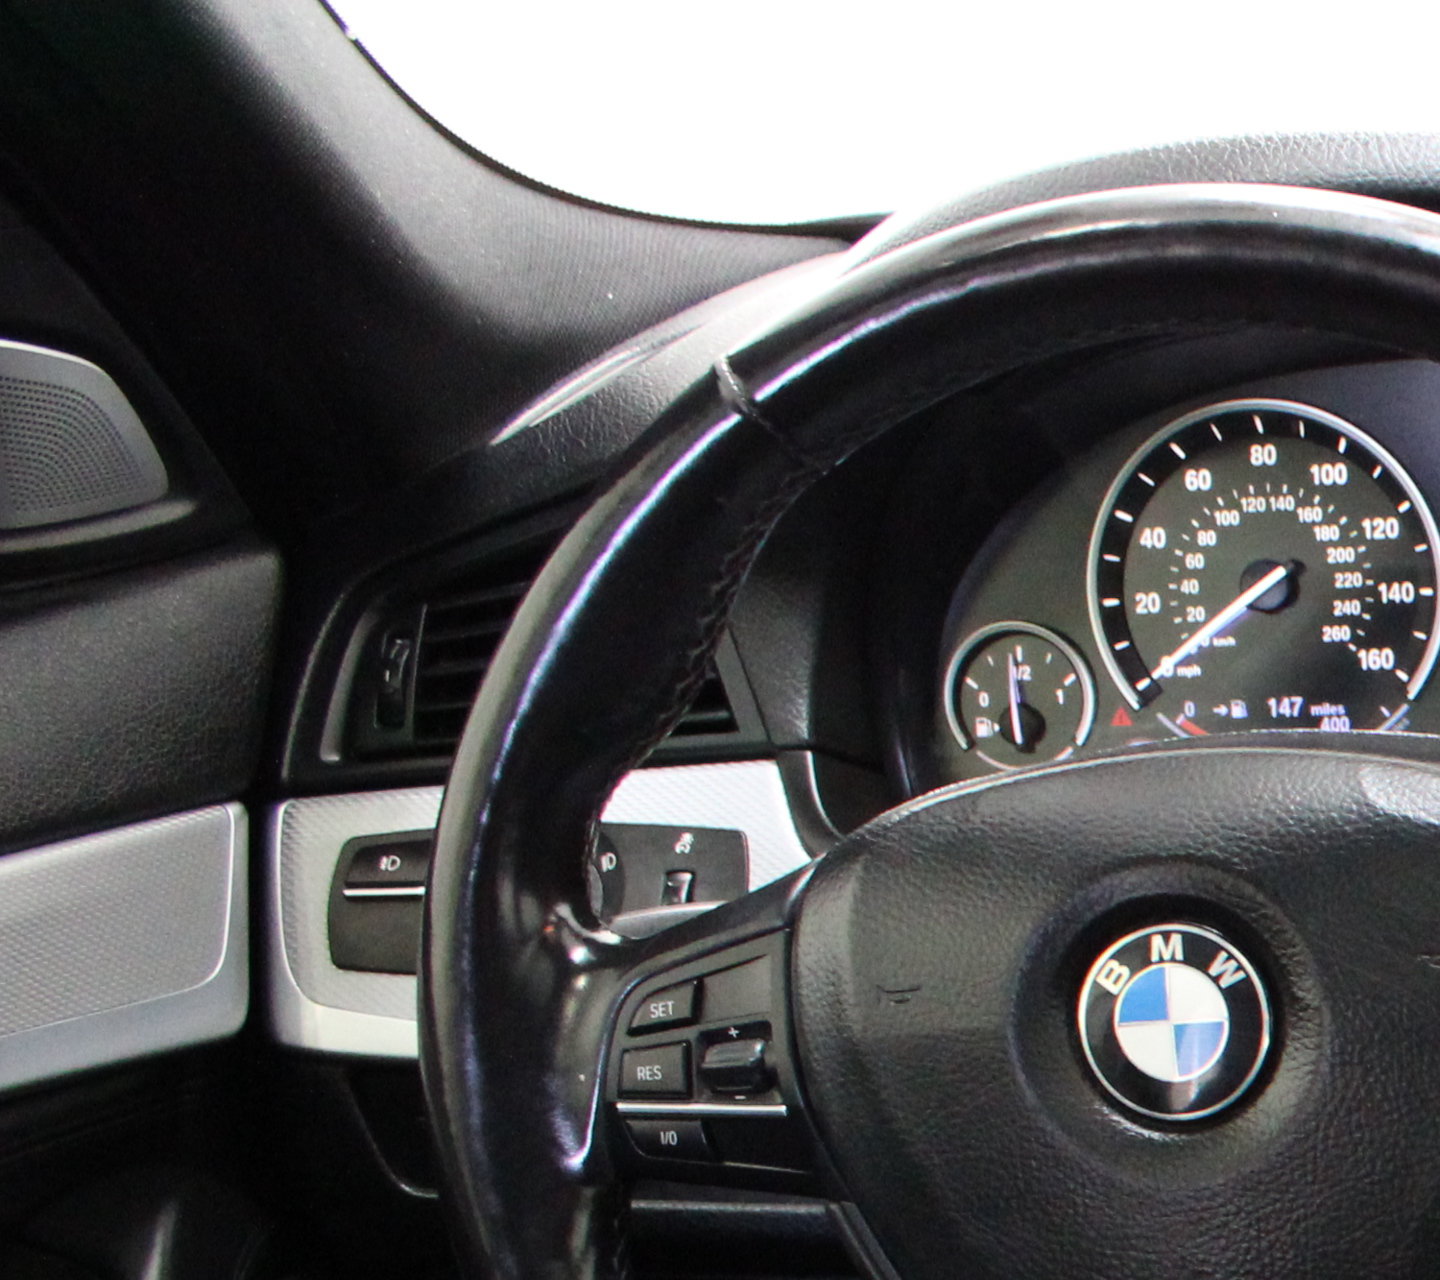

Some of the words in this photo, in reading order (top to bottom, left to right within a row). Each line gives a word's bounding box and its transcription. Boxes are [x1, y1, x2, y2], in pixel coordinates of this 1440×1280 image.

[1250, 443, 1277, 466] 80
[1184, 468, 1212, 491] 60
[1310, 463, 1348, 486] 100
[1241, 496, 1266, 513] 120
[1269, 495, 1295, 512] 140
[1214, 509, 1240, 526] 100
[1297, 506, 1323, 523] 160
[1313, 525, 1340, 542] 180
[1362, 517, 1400, 540] 120
[1140, 526, 1166, 549] 40
[1197, 530, 1217, 547] 80
[1185, 553, 1204, 570] 60
[1326, 547, 1355, 564] 200
[1180, 578, 1199, 595] 40
[1334, 572, 1363, 589] 220
[1378, 581, 1415, 605] 140
[1135, 592, 1161, 614] 20
[1333, 600, 1361, 617] 240
[1186, 606, 1206, 623] 20
[1322, 625, 1351, 643] 260
[1357, 648, 1395, 671] 160
[1177, 665, 1202, 679] mph
[979, 692, 989, 708] 0
[1055, 688, 1065, 705] 1
[1267, 696, 1304, 718] 147
[1310, 702, 1346, 716] miles
[1095, 933, 1247, 995] BMW
[650, 1001, 675, 1019] SET
[636, 1065, 662, 1082] RES
